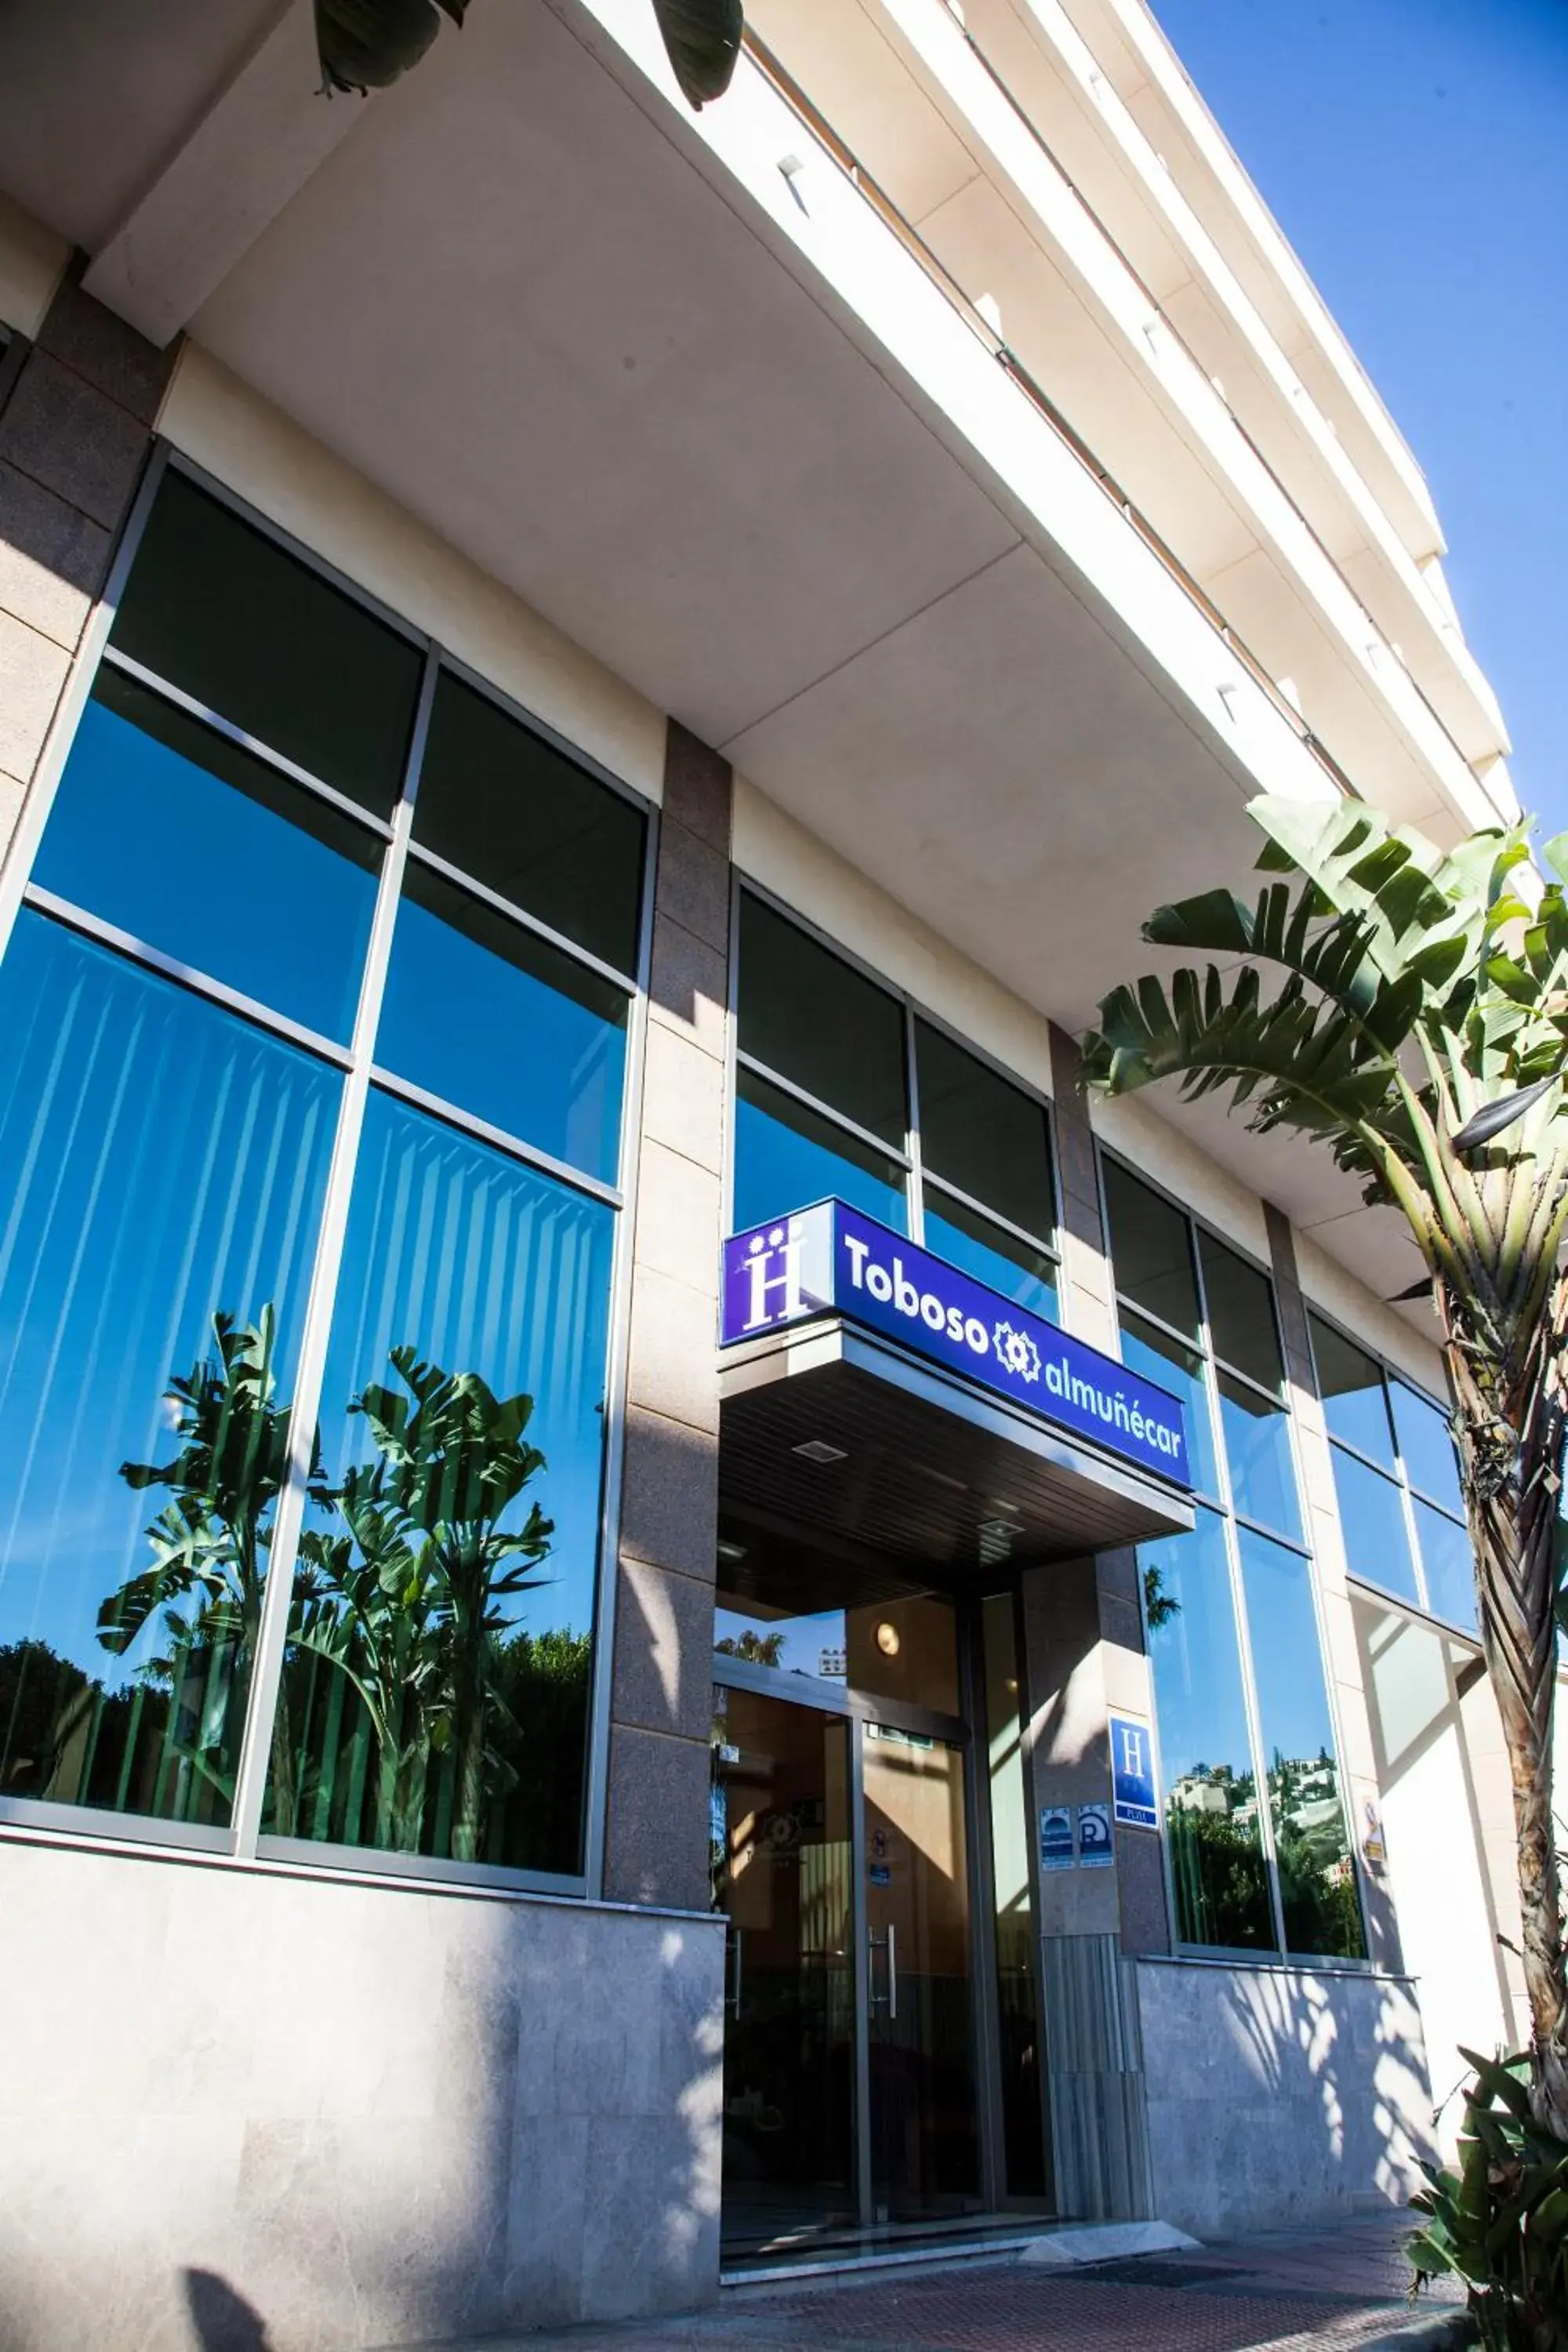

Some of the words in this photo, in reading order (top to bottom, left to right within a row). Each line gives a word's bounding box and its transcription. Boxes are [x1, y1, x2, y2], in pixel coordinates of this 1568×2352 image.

[844, 1234, 989, 1355] Toboso
[1045, 1357, 1181, 1459] almuñécar
[1120, 1728, 1144, 1778] H
